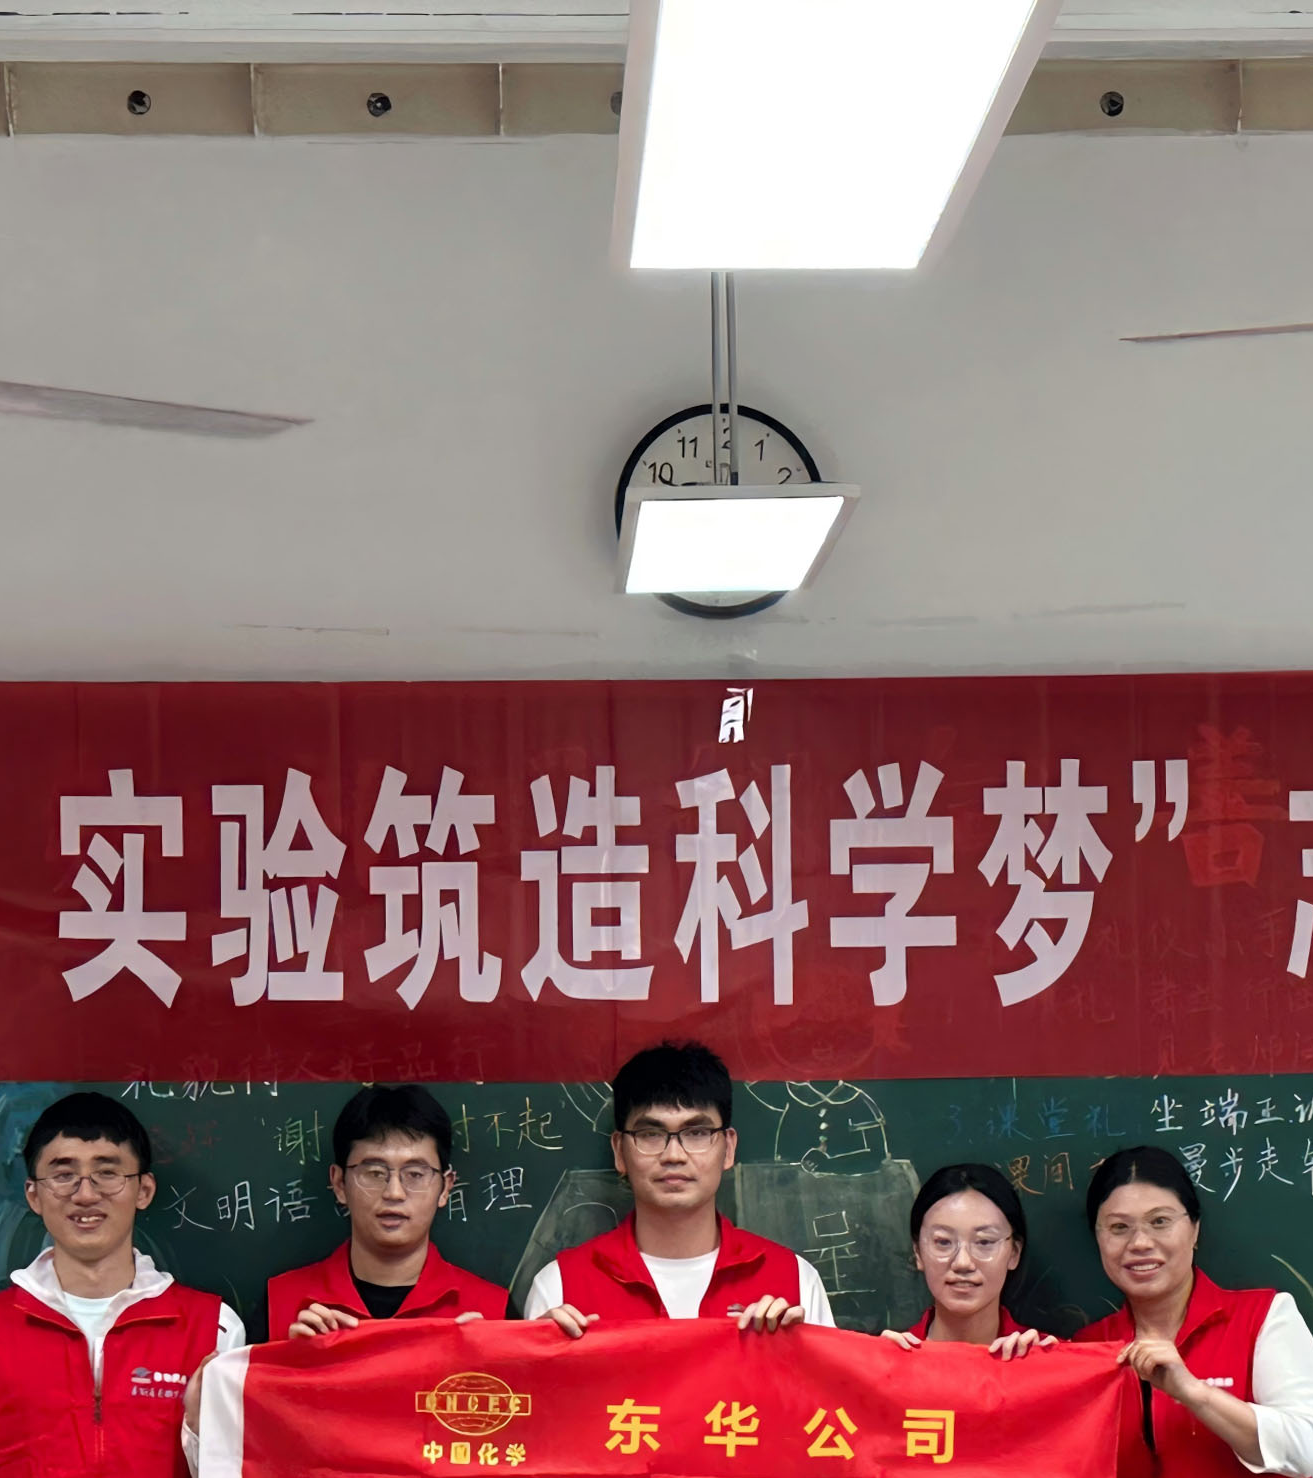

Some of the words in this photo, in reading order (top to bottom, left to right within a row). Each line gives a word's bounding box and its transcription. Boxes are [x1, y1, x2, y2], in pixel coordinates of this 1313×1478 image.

[677, 436, 698, 458] 11
[647, 462, 675, 485] 10
[162, 1178, 350, 1233] 文明语
[605, 1398, 957, 1465] 东华公司
[422, 1440, 526, 1468] 中国化学
